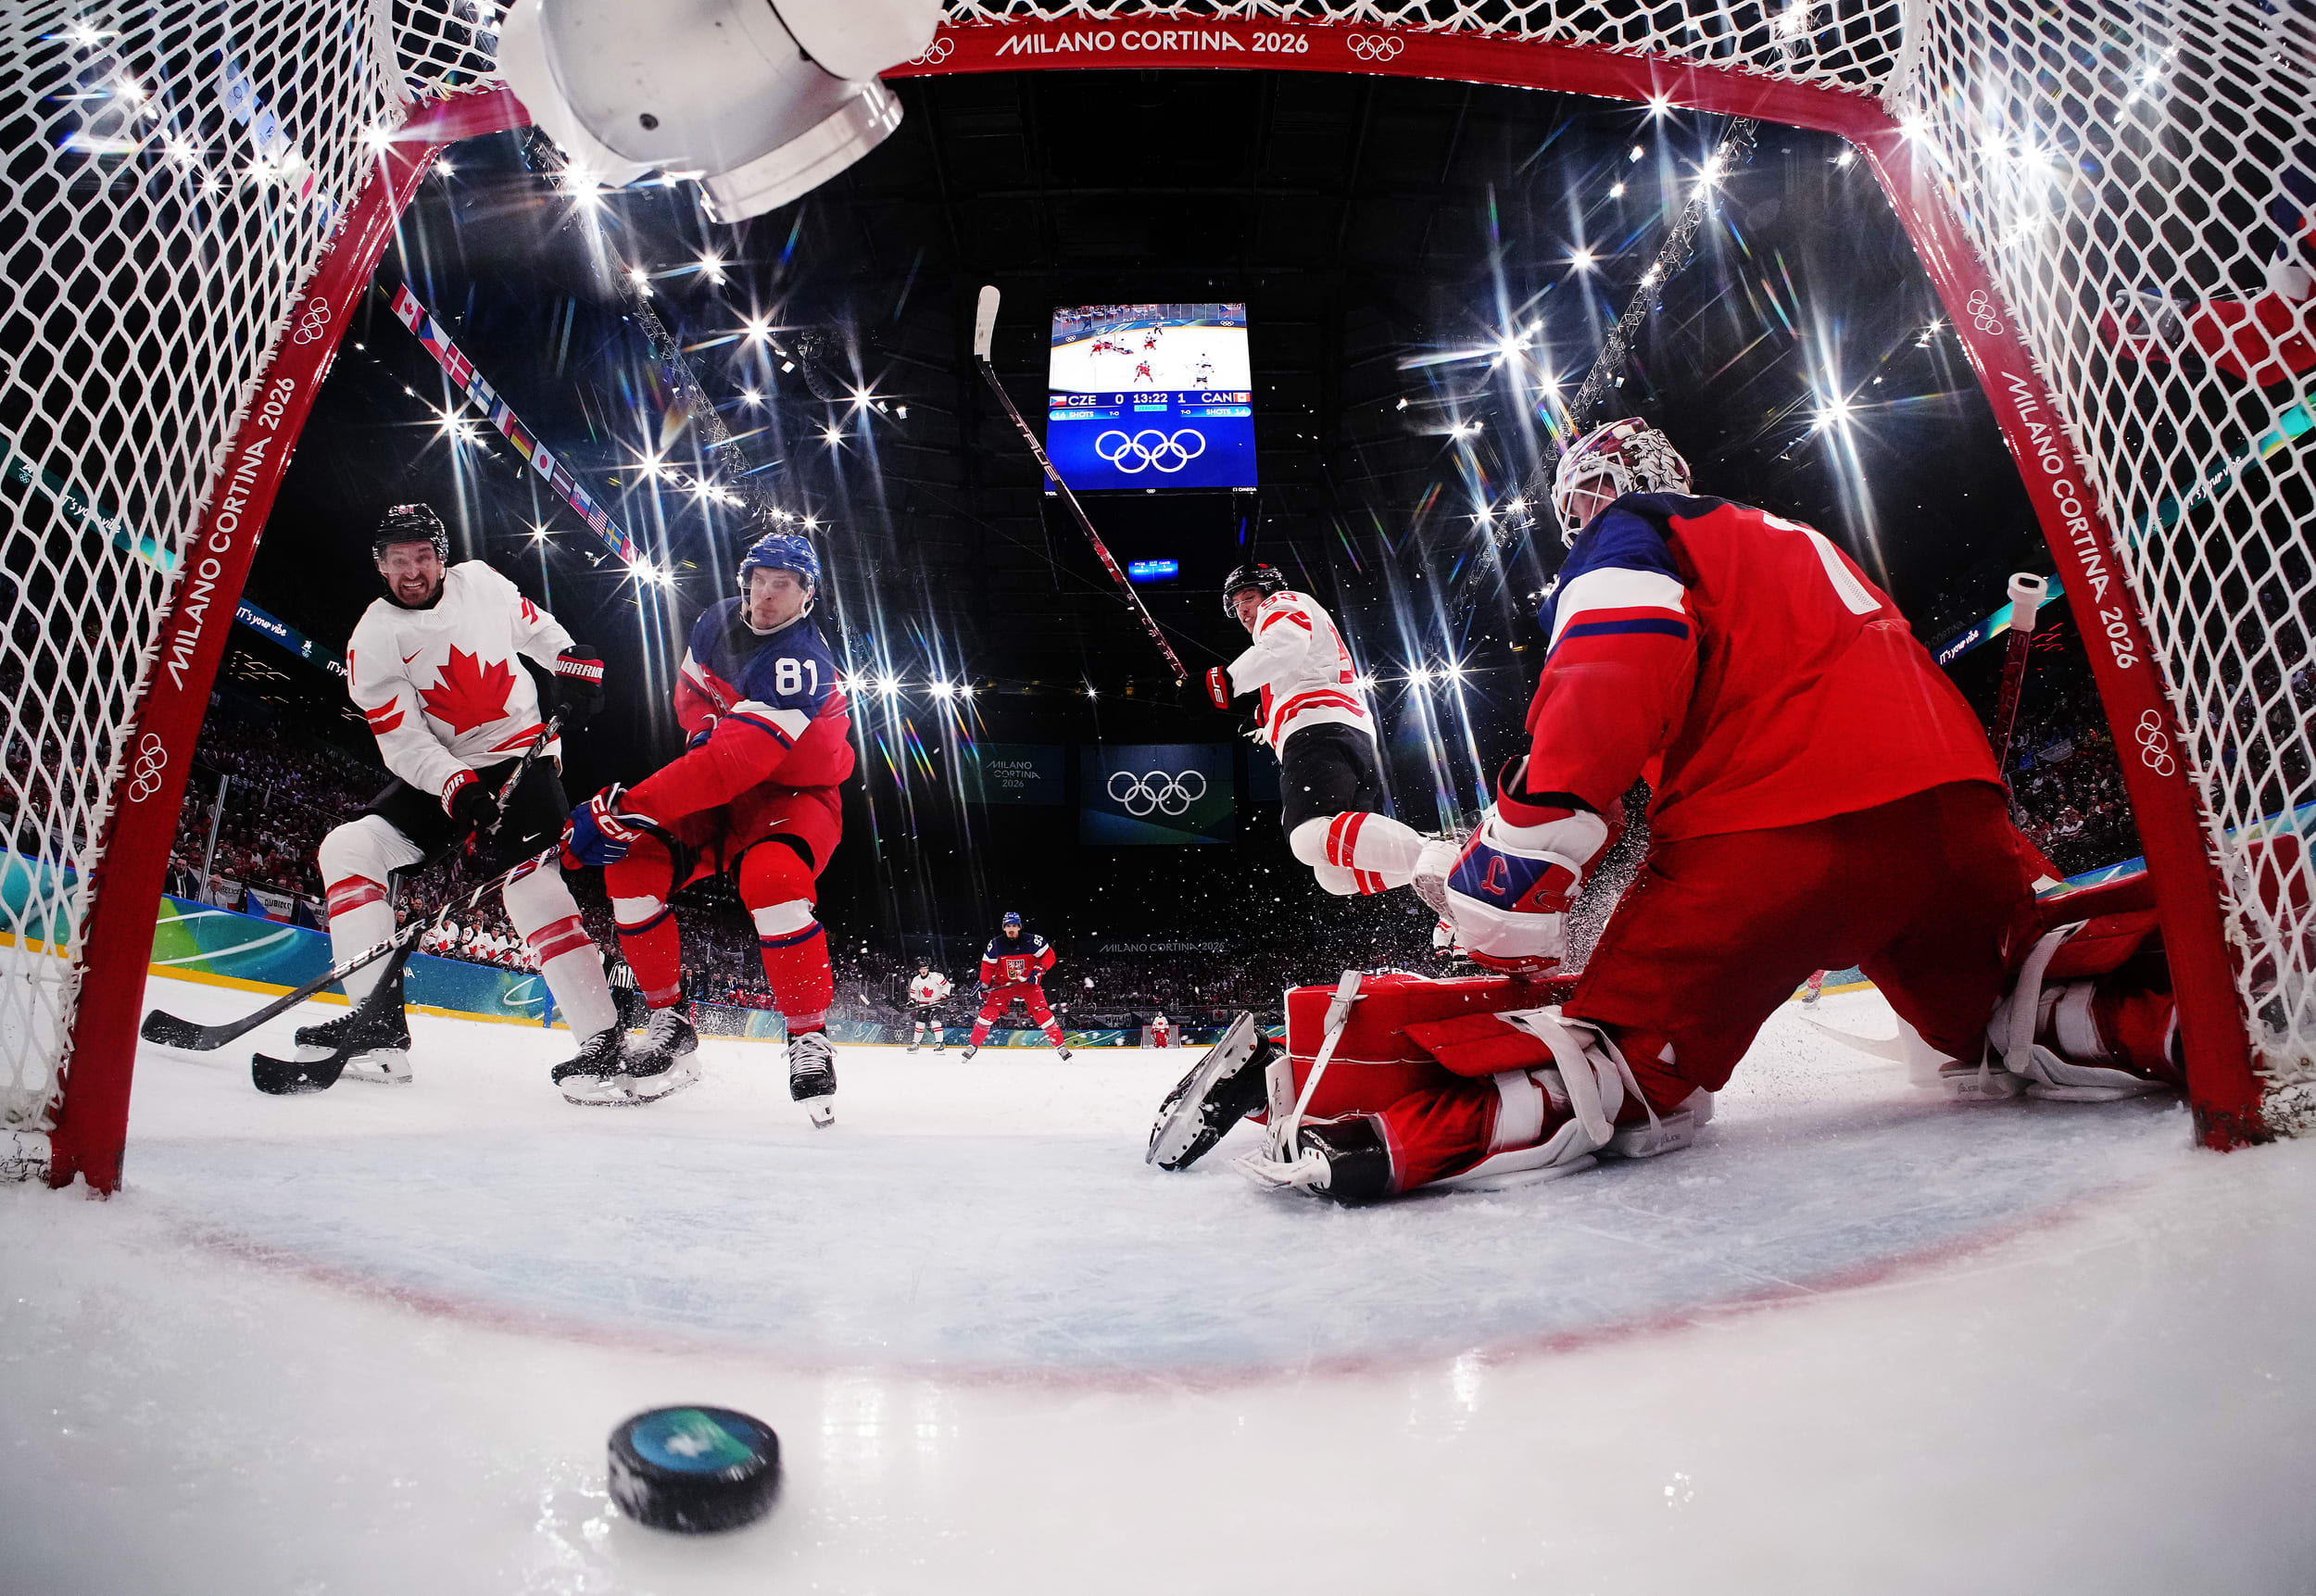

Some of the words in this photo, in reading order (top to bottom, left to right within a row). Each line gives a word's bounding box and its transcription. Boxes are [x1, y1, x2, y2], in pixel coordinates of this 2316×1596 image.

[996, 31, 1114, 56] MILANO
[1121, 31, 1245, 52] CORTINA
[1252, 32, 1309, 53] 2026
[1068, 395, 1097, 406] CZE
[1114, 394, 1124, 405] 0
[1133, 393, 1168, 404] 13:22
[1177, 393, 1187, 403] 1
[1201, 392, 1233, 403] CAN
[2001, 371, 2064, 474] MILANO
[2052, 479, 2109, 604] CORTINA
[2099, 606, 2139, 669] 2026
[168, 558, 221, 692] MILANO
[208, 436, 272, 553] CORTINA
[258, 378, 296, 431] 2026
[1260, 592, 1298, 611] 93
[555, 660, 604, 679] WARRIO
[774, 657, 819, 697] 81
[1210, 666, 1224, 703] RUE
[986, 760, 1032, 770] MILANO
[993, 770, 1041, 779] CORTINA
[1001, 779, 1025, 787] 2026
[591, 794, 642, 843] CCM
[1099, 943, 1148, 953] MILANO
[1150, 941, 1201, 952] CORTINA
[1202, 941, 1226, 951] 2026
